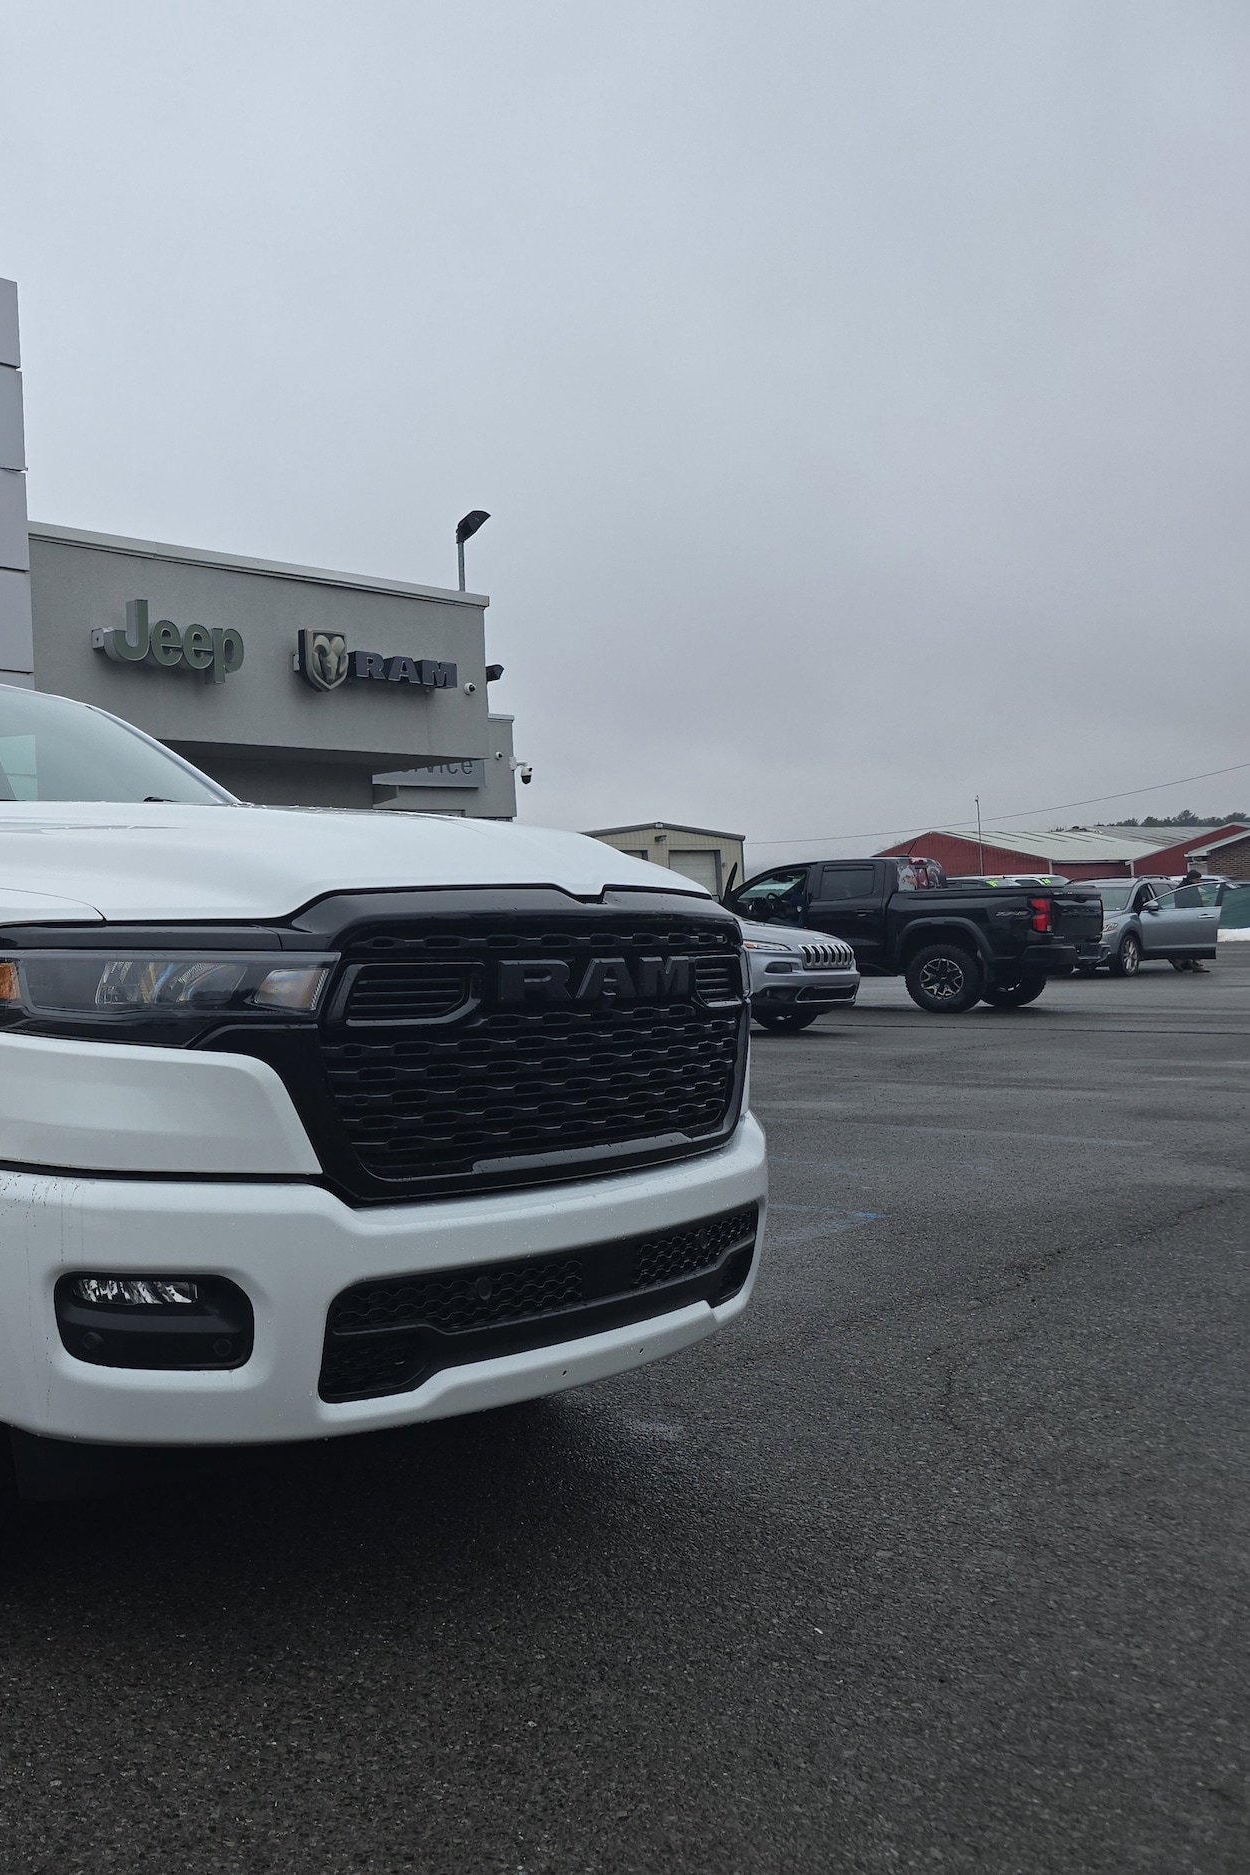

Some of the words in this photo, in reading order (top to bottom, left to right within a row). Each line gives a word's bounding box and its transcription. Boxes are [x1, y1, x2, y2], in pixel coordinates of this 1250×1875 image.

[103, 599, 244, 684] Jeep
[352, 650, 457, 689] RAM
[498, 955, 692, 1001] RAM
